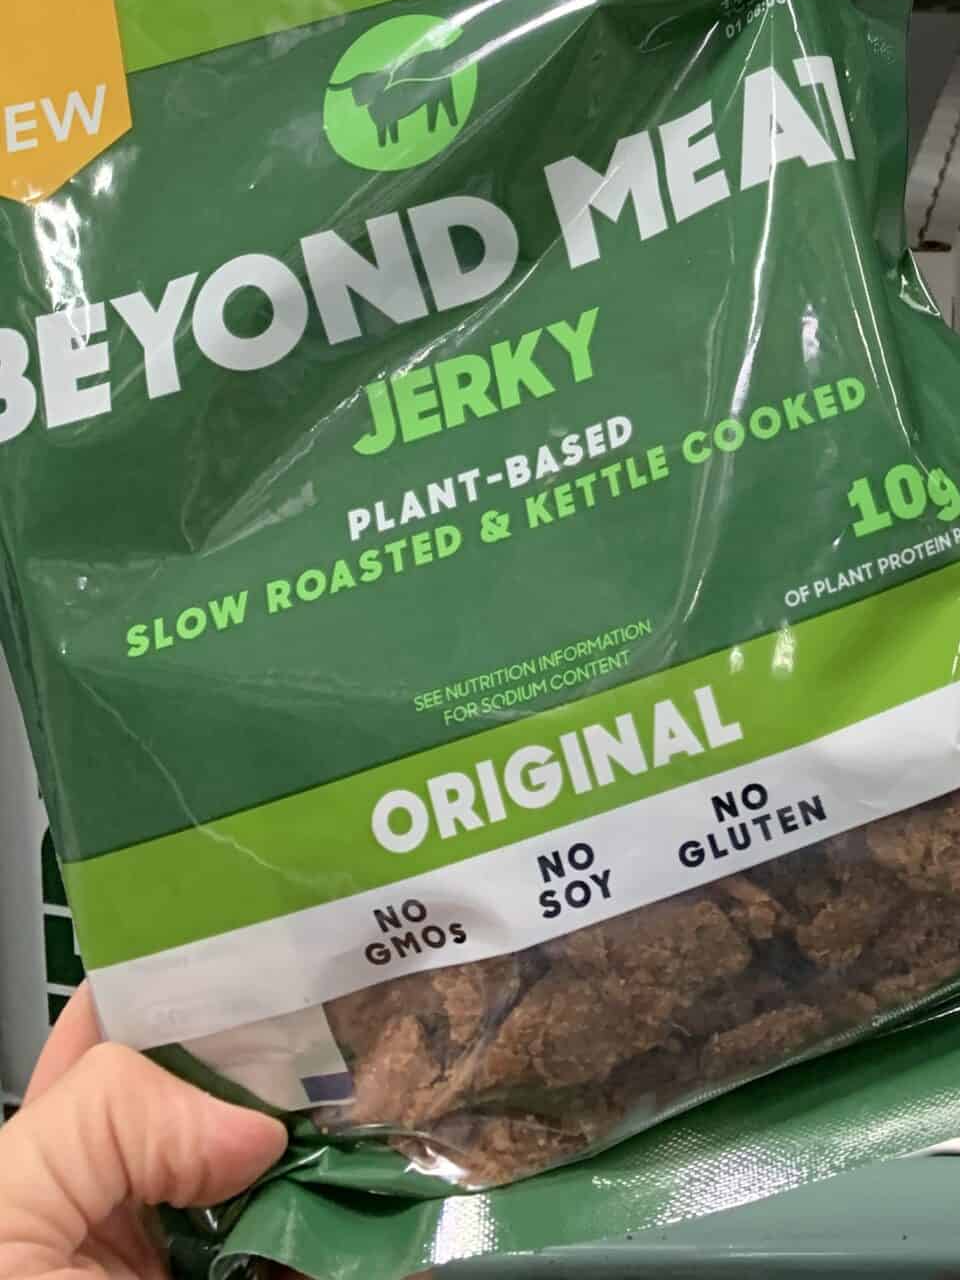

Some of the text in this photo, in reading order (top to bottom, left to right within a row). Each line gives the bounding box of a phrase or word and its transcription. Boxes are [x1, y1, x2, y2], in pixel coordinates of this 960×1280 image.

[4, 83, 107, 153] EW
[544, 56, 856, 270] MEAT
[352, 307, 601, 456] JERKY
[347, 414, 634, 542] PLANT-BASED
[126, 376, 867, 657] SLOW ROASTED & KETTLE COOKED
[784, 584, 812, 608] OF
[814, 562, 873, 598] PLANT
[877, 531, 953, 576] PROTEIN
[413, 619, 652, 713] SEE NUTRITION INFORMATION
[443, 650, 631, 726] FOR SODIUM CONTENT
[371, 685, 744, 854] ORIGINAL
[711, 782, 770, 823] NO
[537, 842, 596, 883] NO
[678, 794, 828, 869] GLUTEN
[373, 899, 428, 934] NO
[538, 869, 612, 920] SOY
[364, 921, 468, 967] GMOs
